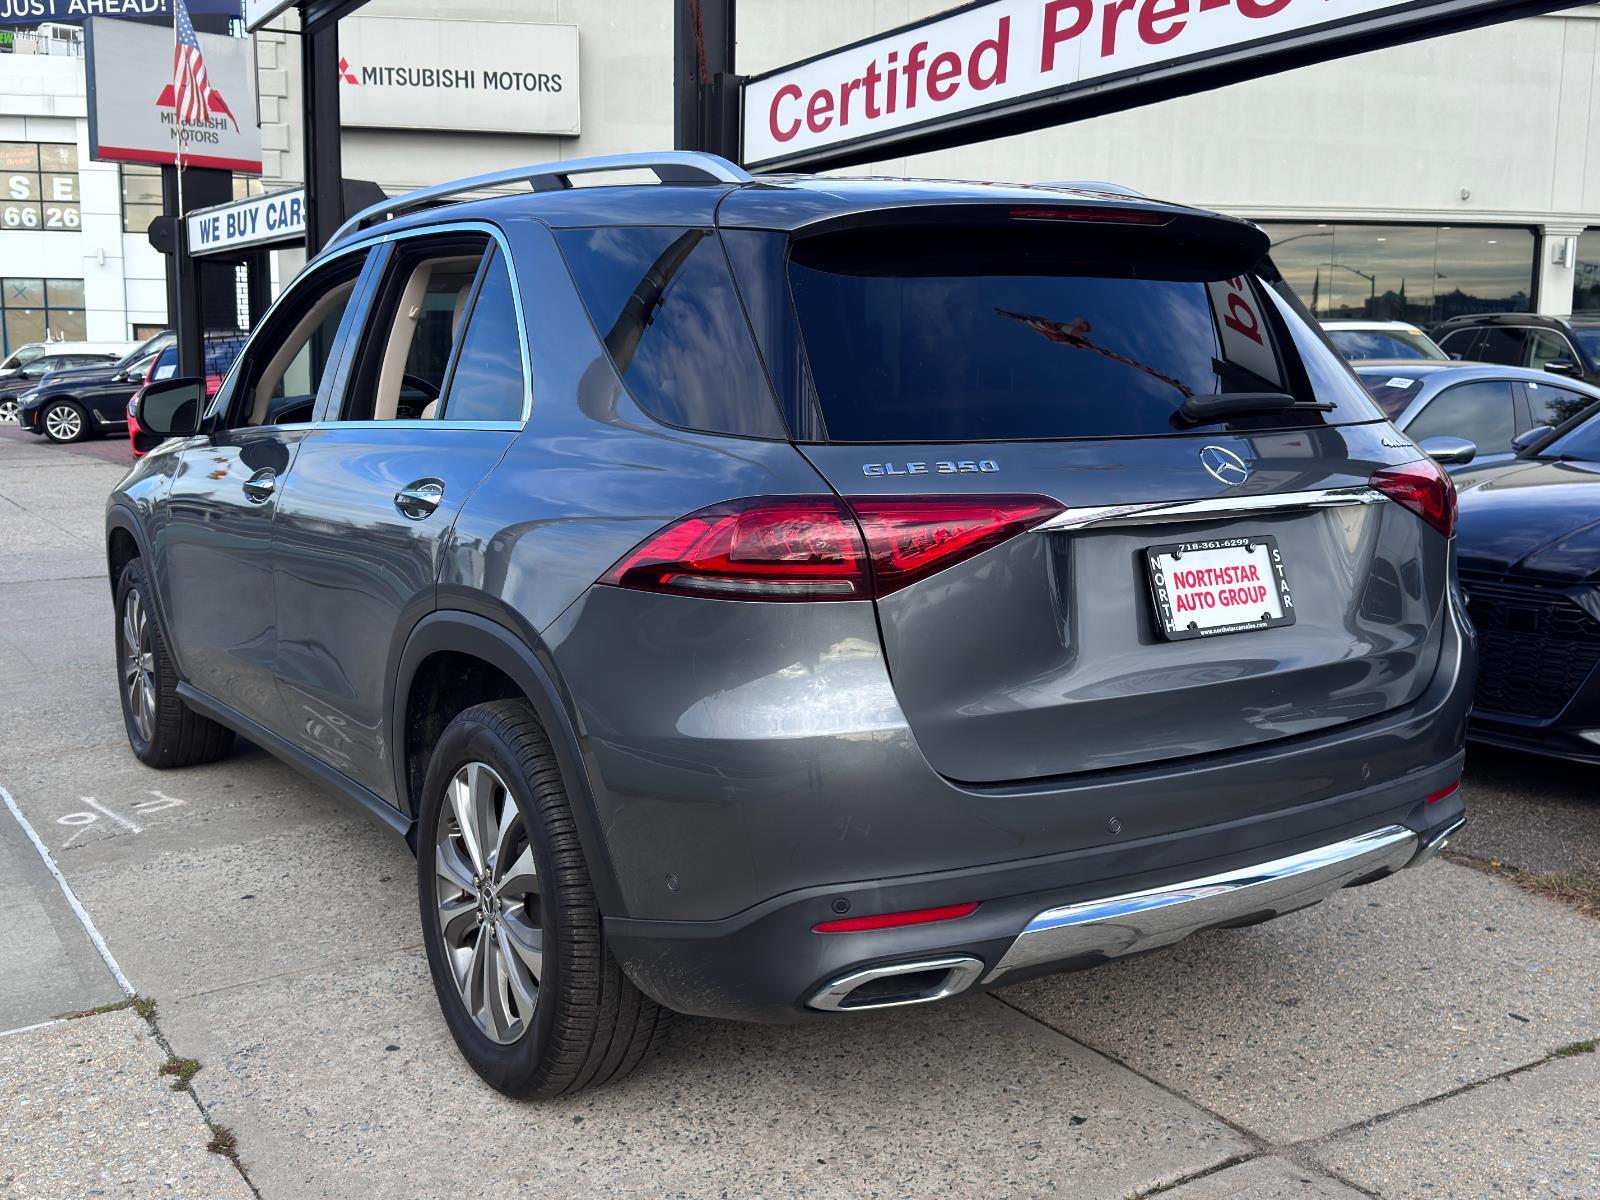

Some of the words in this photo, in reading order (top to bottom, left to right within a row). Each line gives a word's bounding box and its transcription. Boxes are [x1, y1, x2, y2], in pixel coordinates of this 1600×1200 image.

[362, 66, 475, 89] MITSUBISHI
[484, 71, 562, 93] MOTORS
[769, 15, 1010, 142] Certifed
[1041, 0, 1294, 73] Pre-
[160, 112, 227, 130] MISUBISHI
[170, 128, 219, 144] MOTORS
[4, 207, 38, 227] 66
[46, 207, 80, 227] 26
[200, 216, 220, 244] WE
[227, 207, 259, 239] BUY
[266, 198, 305, 231] CAR
[863, 462, 929, 476] GLE
[935, 460, 1000, 475] 350
[1178, 539, 1249, 552] 718-361-6299
[1173, 564, 1260, 590] NORTHSTAR
[1272, 549, 1293, 608] STAR
[1150, 556, 1177, 633] NORTH
[1176, 592, 1216, 613] AUTO
[1218, 585, 1267, 607] GROUP
